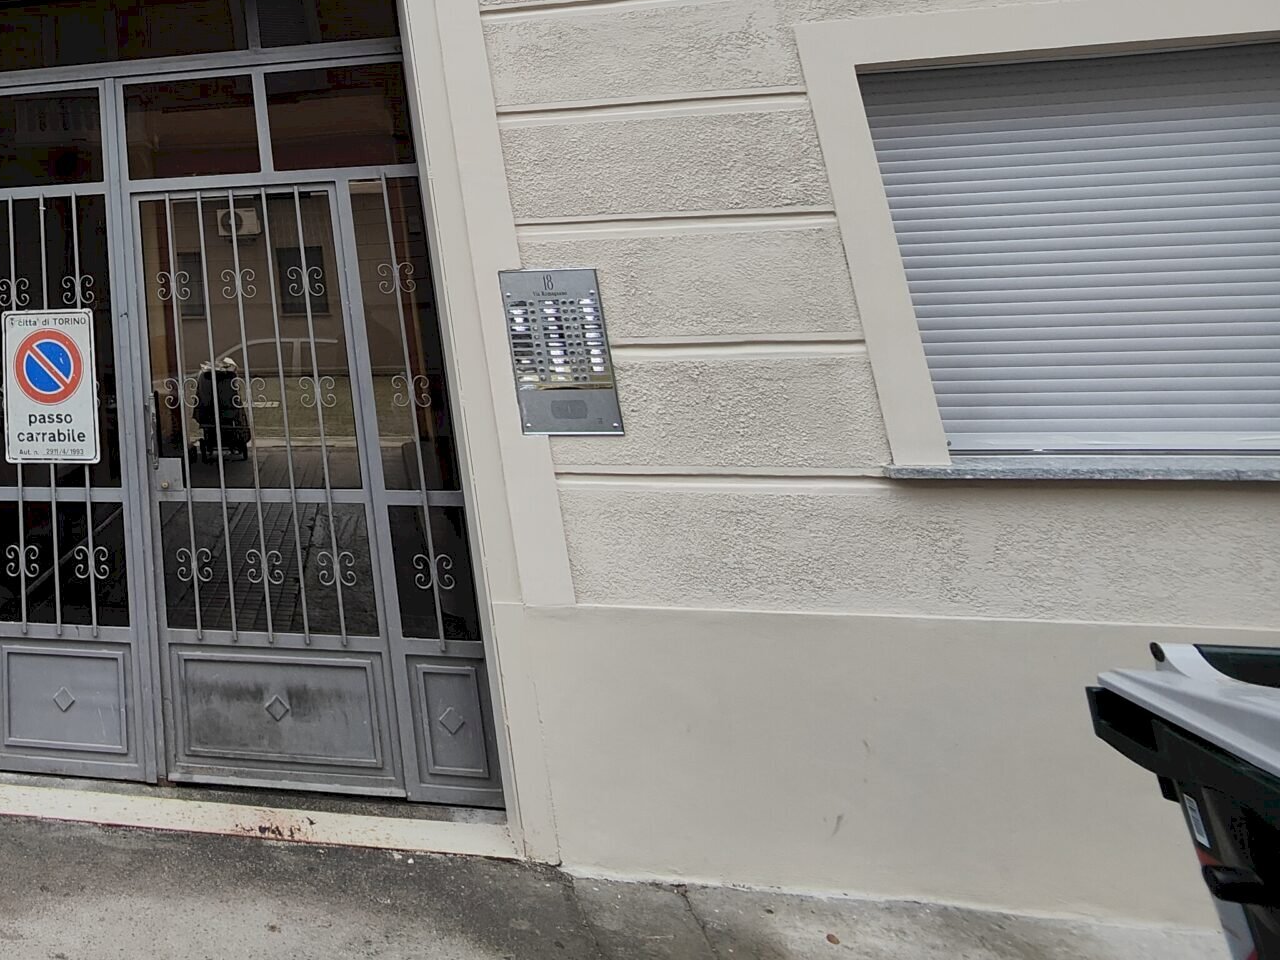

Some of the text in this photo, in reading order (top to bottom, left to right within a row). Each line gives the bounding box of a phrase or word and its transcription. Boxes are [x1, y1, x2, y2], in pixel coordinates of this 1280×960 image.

[542, 274, 554, 290] 18
[42, 317, 50, 326] di
[53, 317, 87, 326] TORINO
[28, 413, 73, 427] passo
[17, 428, 86, 443] carrabile
